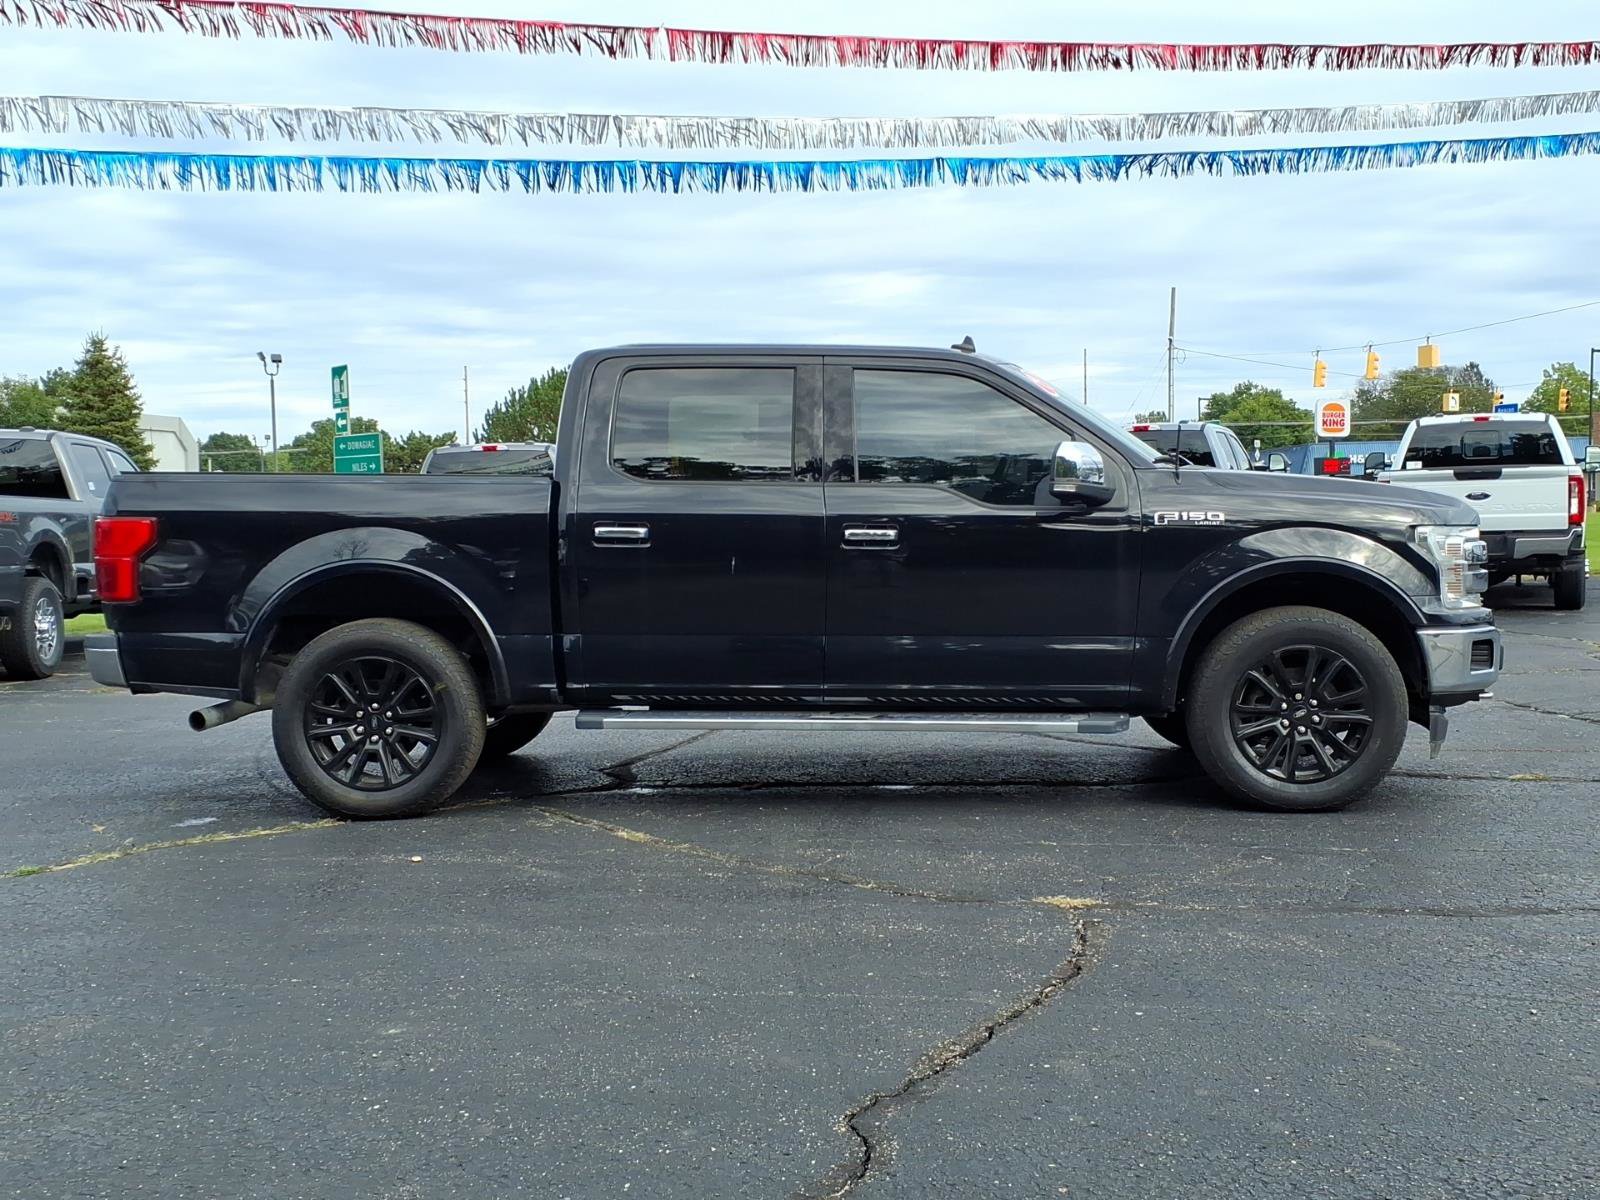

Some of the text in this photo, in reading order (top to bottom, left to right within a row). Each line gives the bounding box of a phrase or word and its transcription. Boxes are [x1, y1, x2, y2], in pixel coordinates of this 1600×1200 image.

[1322, 419, 1345, 427] KING
[347, 440, 375, 450] DOWAGIAC
[351, 462, 368, 472] NILES
